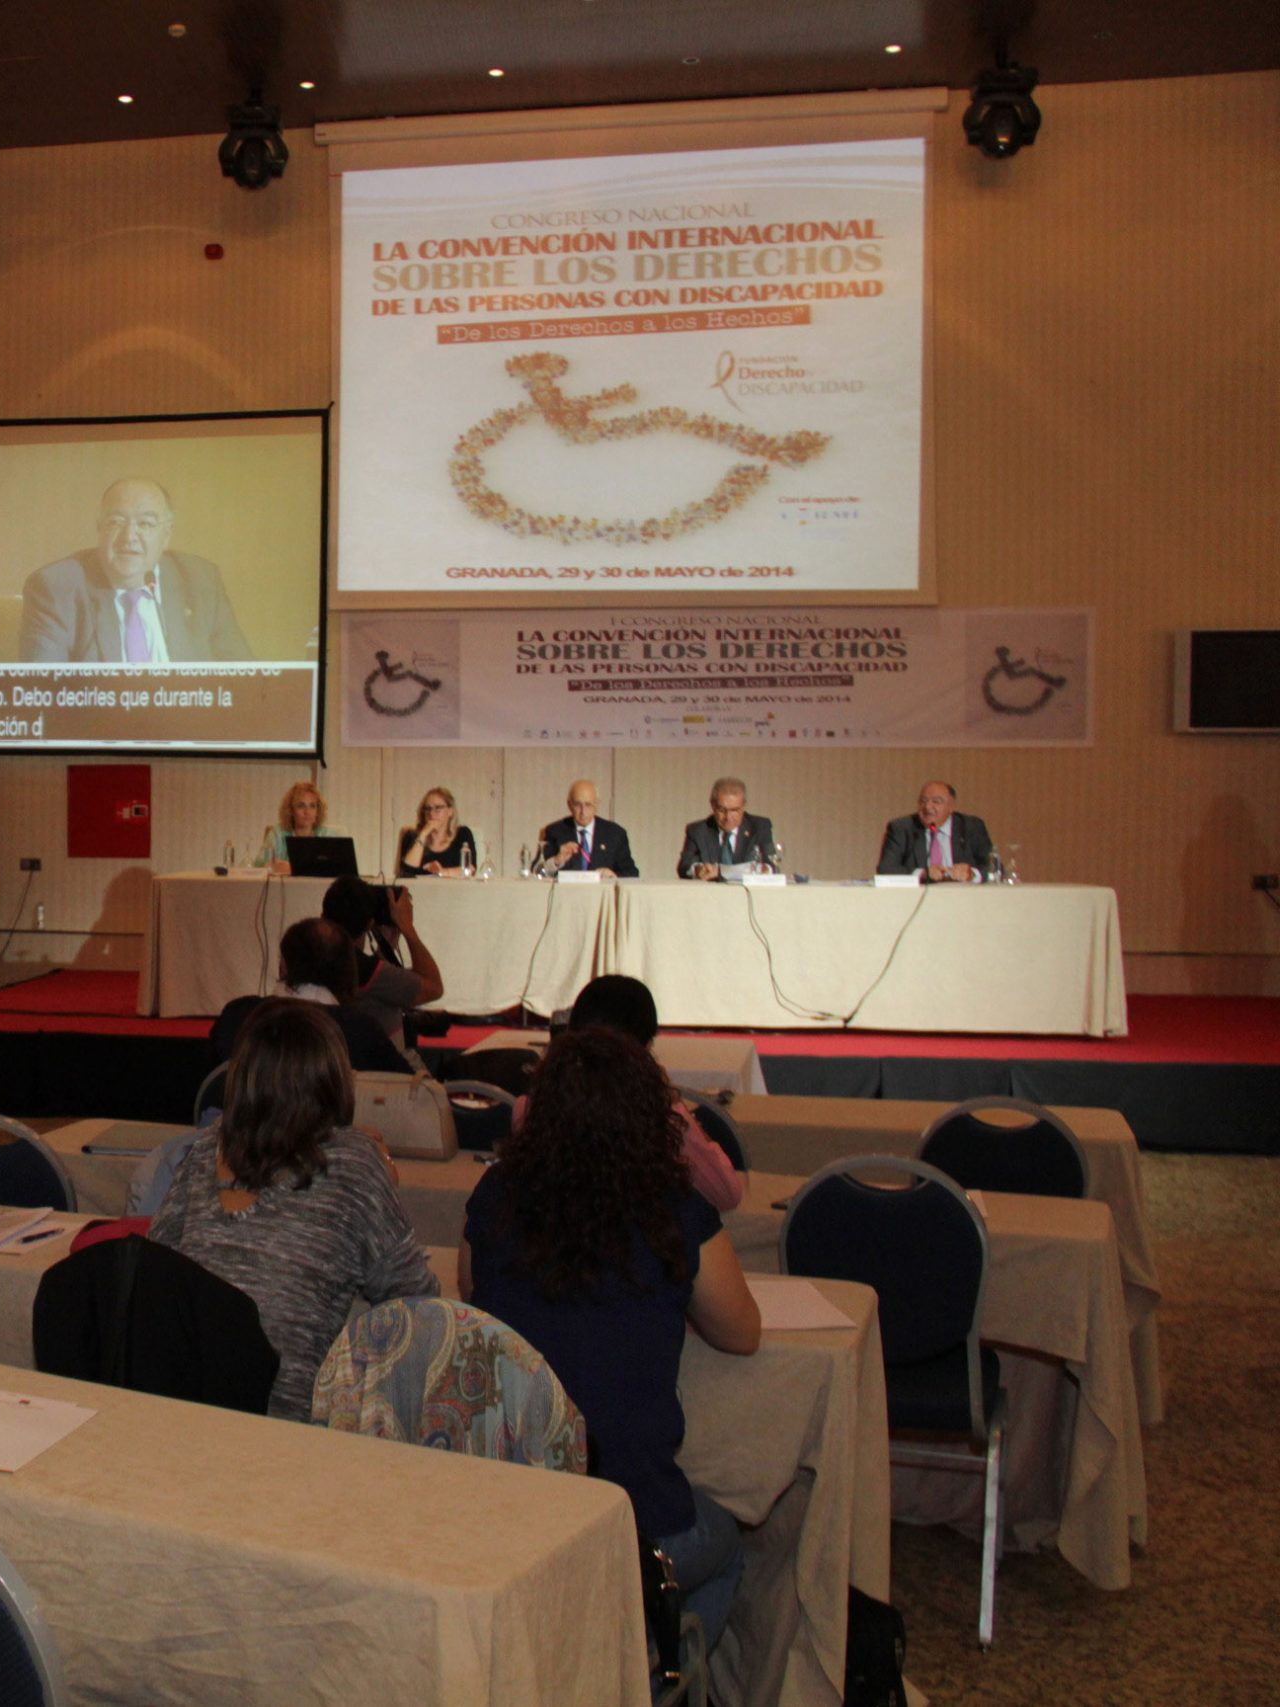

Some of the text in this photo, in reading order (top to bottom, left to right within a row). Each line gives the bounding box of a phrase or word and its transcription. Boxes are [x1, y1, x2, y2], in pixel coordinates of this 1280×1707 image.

[491, 202, 756, 230] CONGRESO NACIONAL
[373, 218, 884, 262] LA CONVENCIÓN INTERNACIONAL
[372, 243, 883, 293] SOBRE LOS DERECHOS
[371, 279, 884, 317] DE LAS PERSONAS CON DISCAPACIDAD
[489, 323, 521, 340] los
[529, 319, 635, 338] Derechos
[642, 318, 657, 331] a
[665, 315, 697, 330] los
[738, 366, 806, 380] Derecho
[738, 380, 865, 396] DISCAPACIDAD
[445, 566, 795, 581] GRANADA, 29 y 30 de MAYO de 2014
[620, 616, 722, 626] CONGRESO
[726, 615, 823, 625] NACIONAL
[517, 627, 907, 643] LA CONVENCIÓN INTERNACIONAL
[516, 641, 908, 661] SOBRE LOS DERECHOS
[516, 661, 909, 675] DE LAS PERSONAS CON DISCAPACIDAD
[640, 678, 722, 689] Derechos
[13, 686, 53, 707] Debo
[56, 686, 117, 707] decirles
[120, 690, 150, 712] que
[153, 686, 214, 707] durante
[217, 686, 233, 707] la
[745, 695, 791, 703] MAYO
[816, 695, 852, 703] 2014
